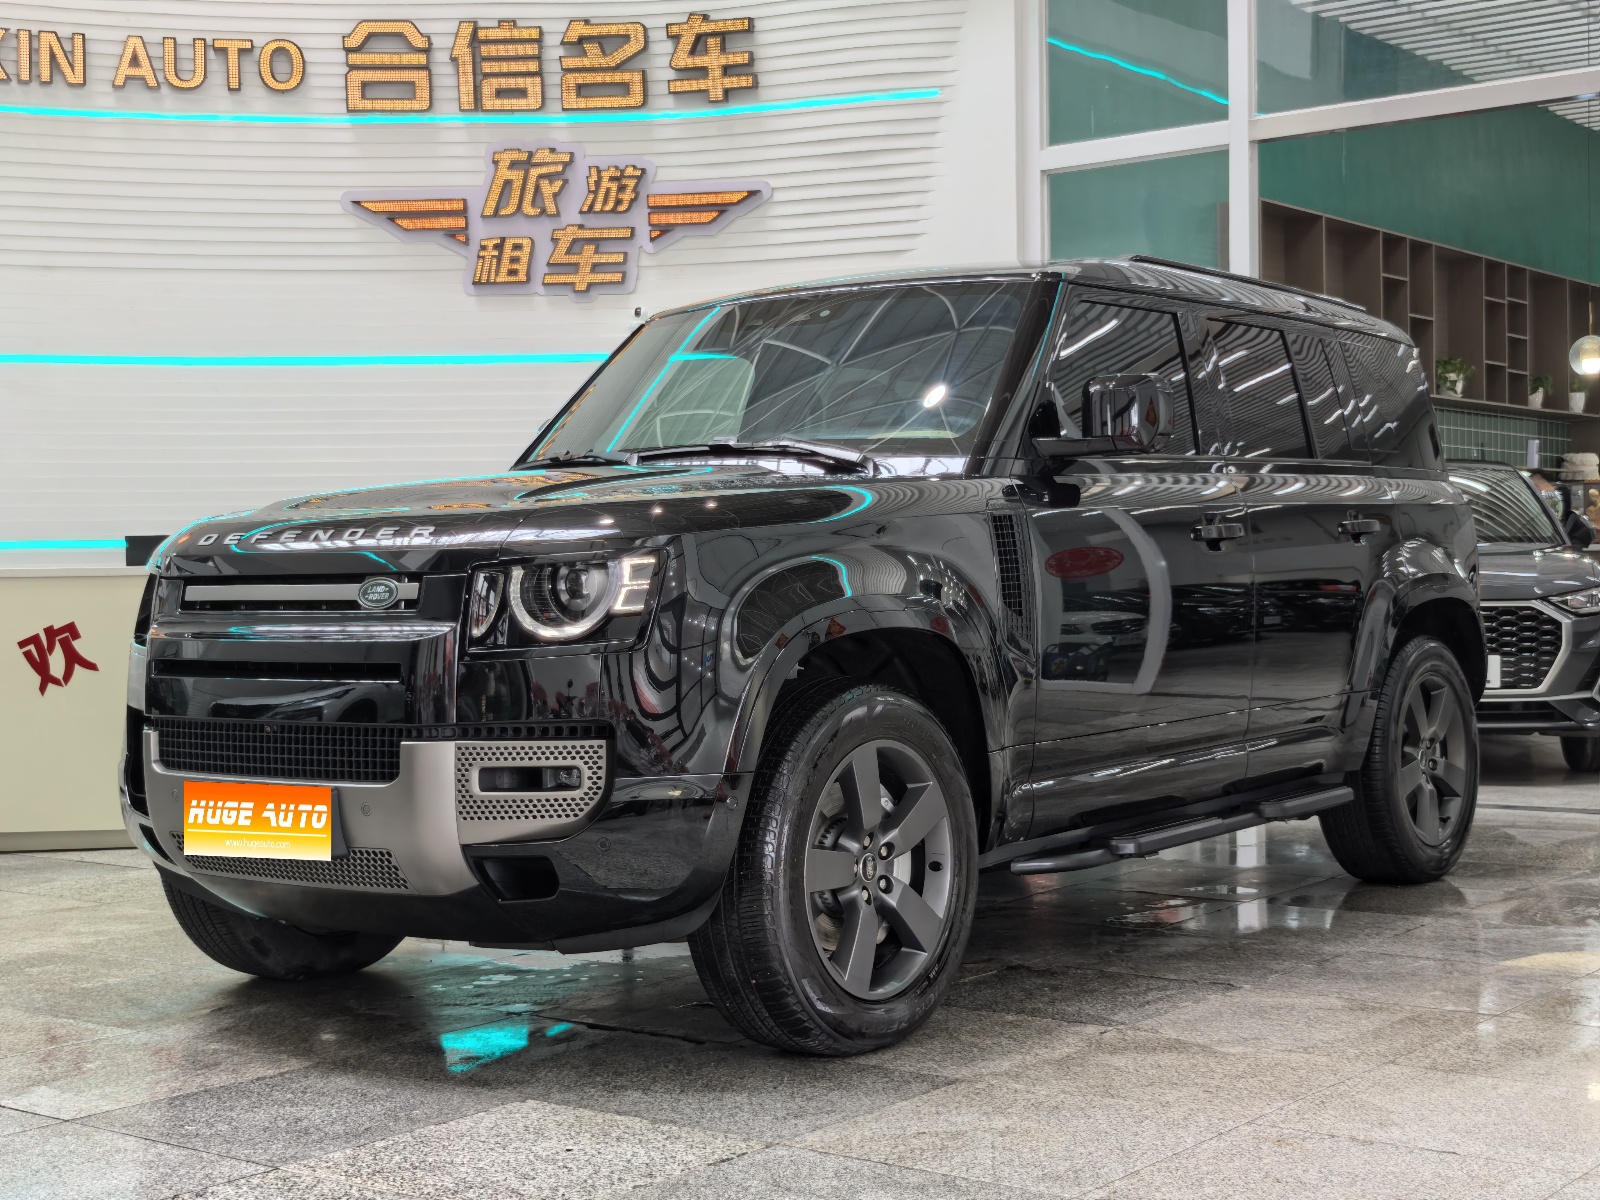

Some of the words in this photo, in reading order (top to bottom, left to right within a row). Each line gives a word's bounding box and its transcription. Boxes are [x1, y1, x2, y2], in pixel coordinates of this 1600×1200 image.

[0, 28, 86, 87] IN
[112, 35, 306, 92] AUTO
[343, 13, 758, 112] 合信名车
[481, 147, 646, 219] 旅游
[472, 224, 635, 293] 租车
[197, 525, 436, 546] DEFENDER
[367, 585, 386, 593] LAND
[368, 592, 390, 600] ROVER
[17, 621, 99, 697] 欢
